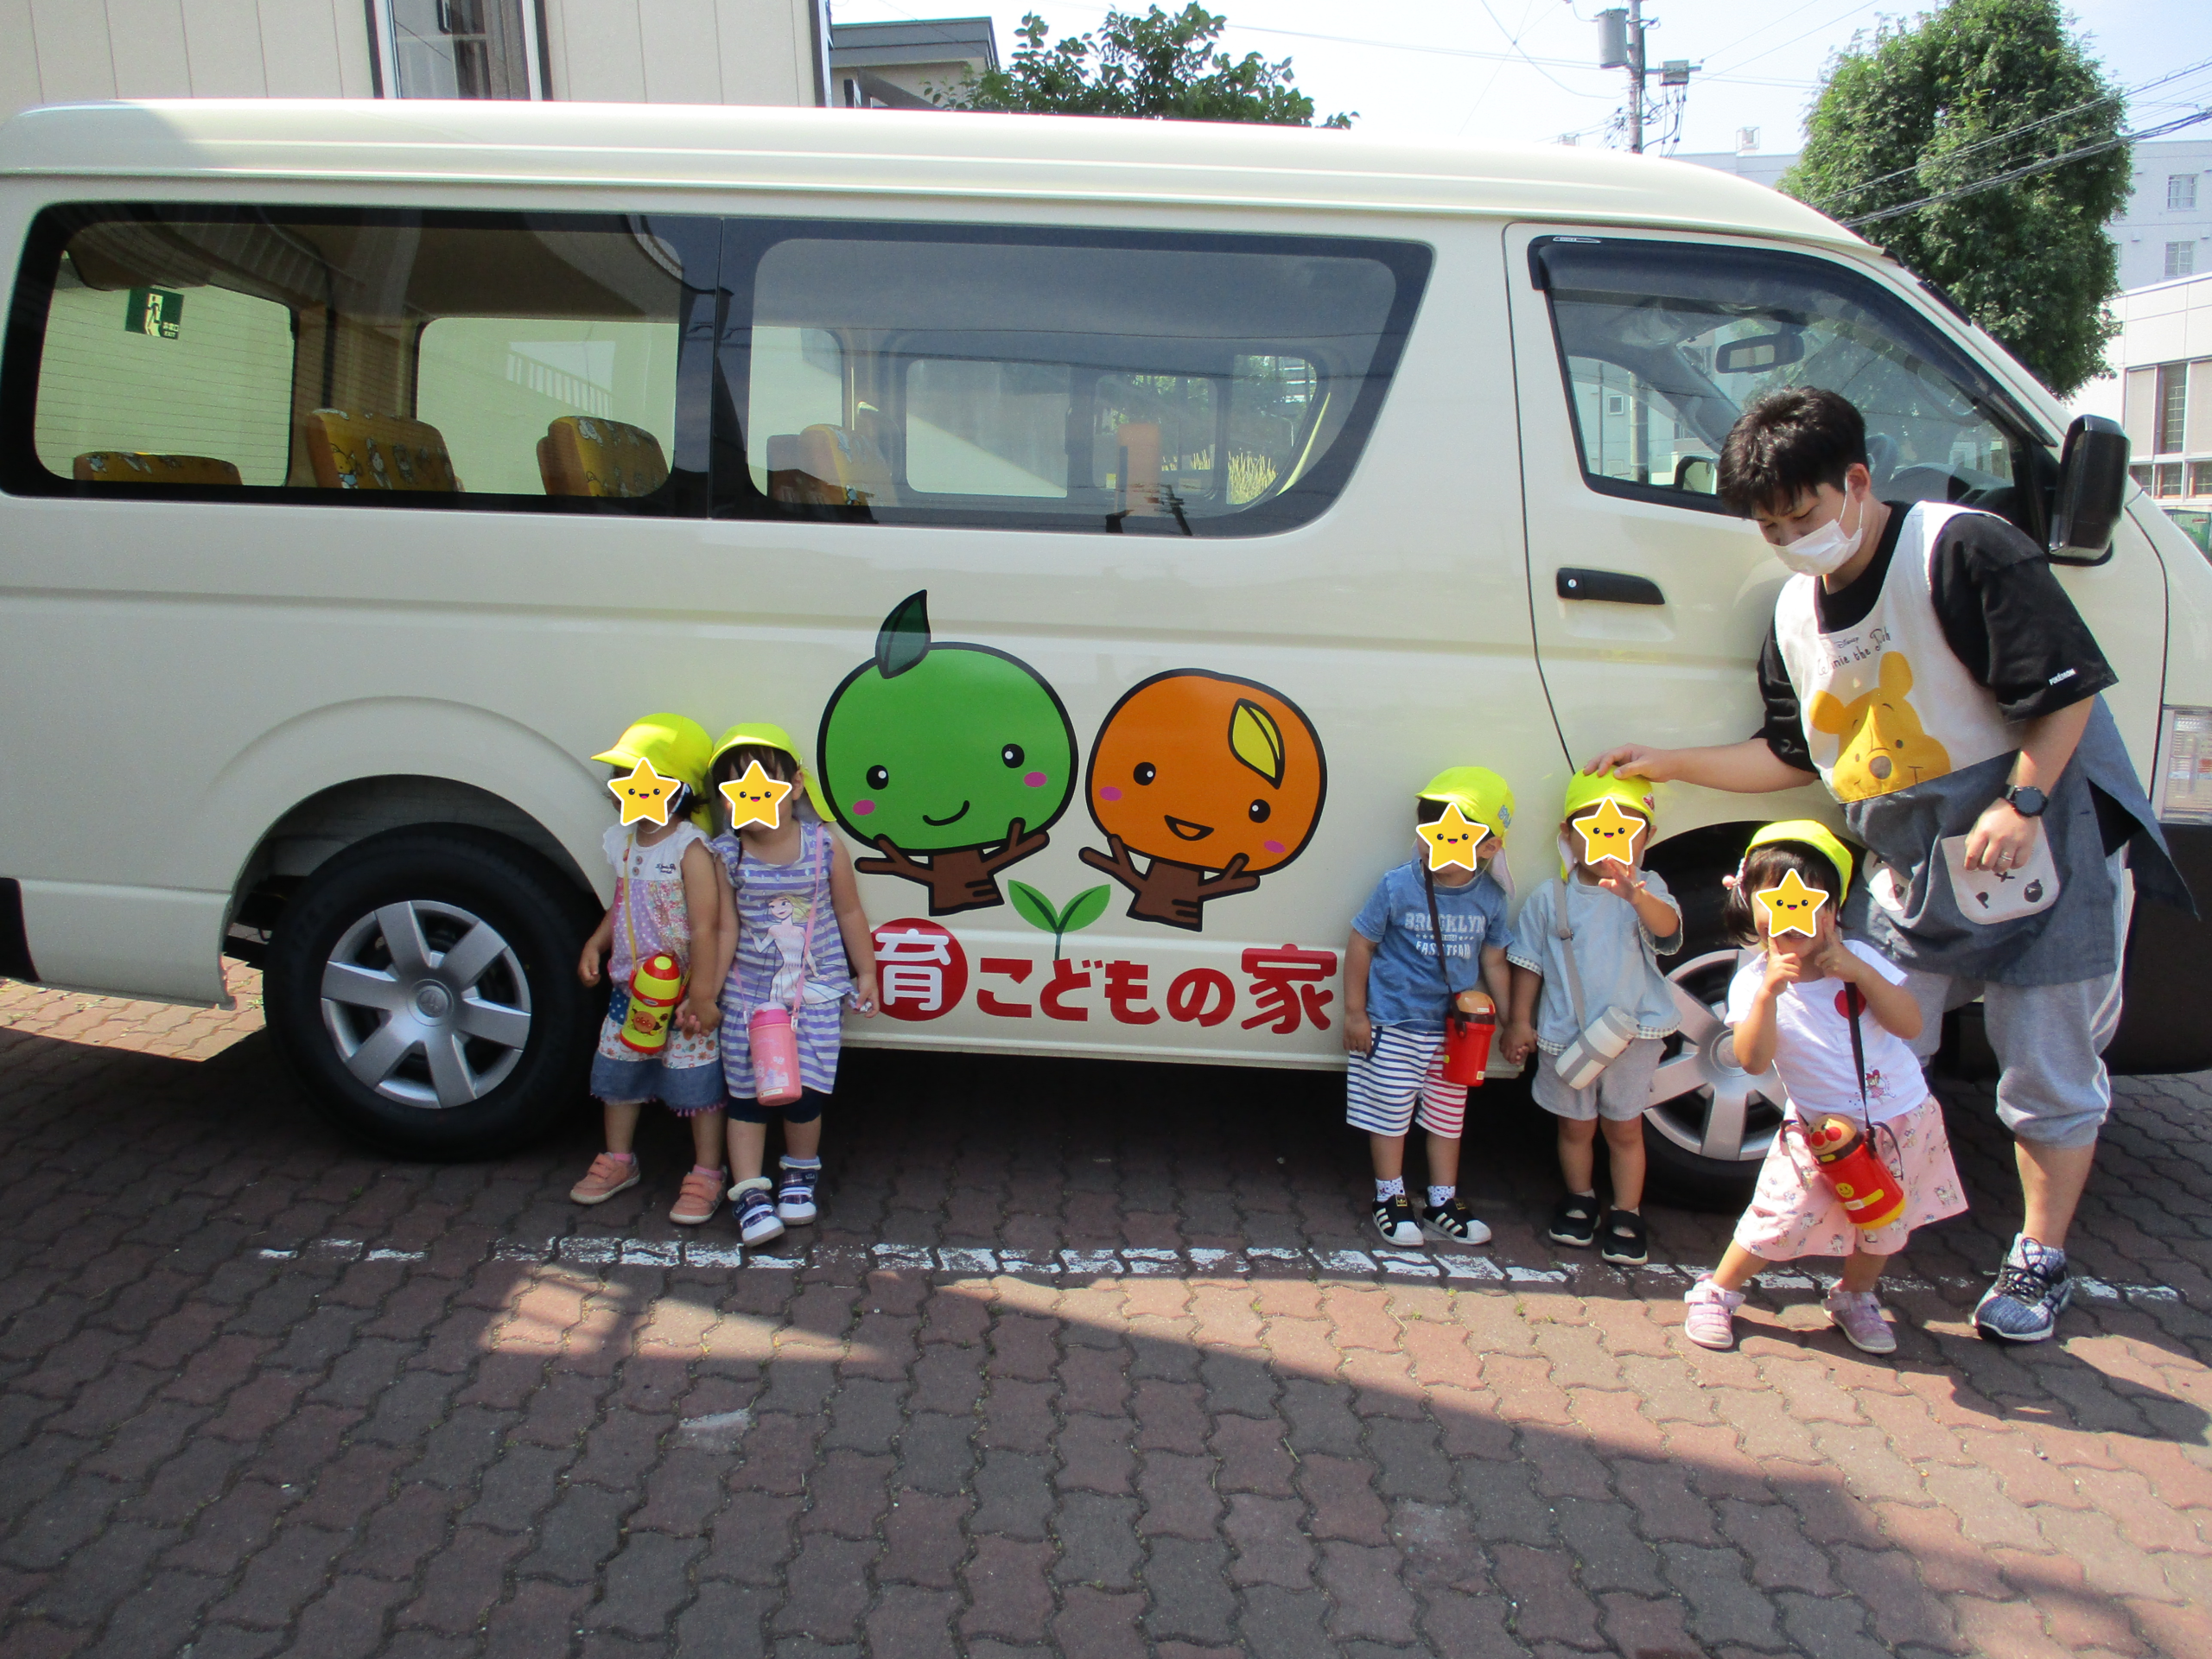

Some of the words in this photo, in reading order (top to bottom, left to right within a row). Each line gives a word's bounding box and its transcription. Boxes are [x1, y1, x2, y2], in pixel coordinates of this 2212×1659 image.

[1853, 646, 1871, 661] the
[976, 943, 1338, 1035] こどもの家
